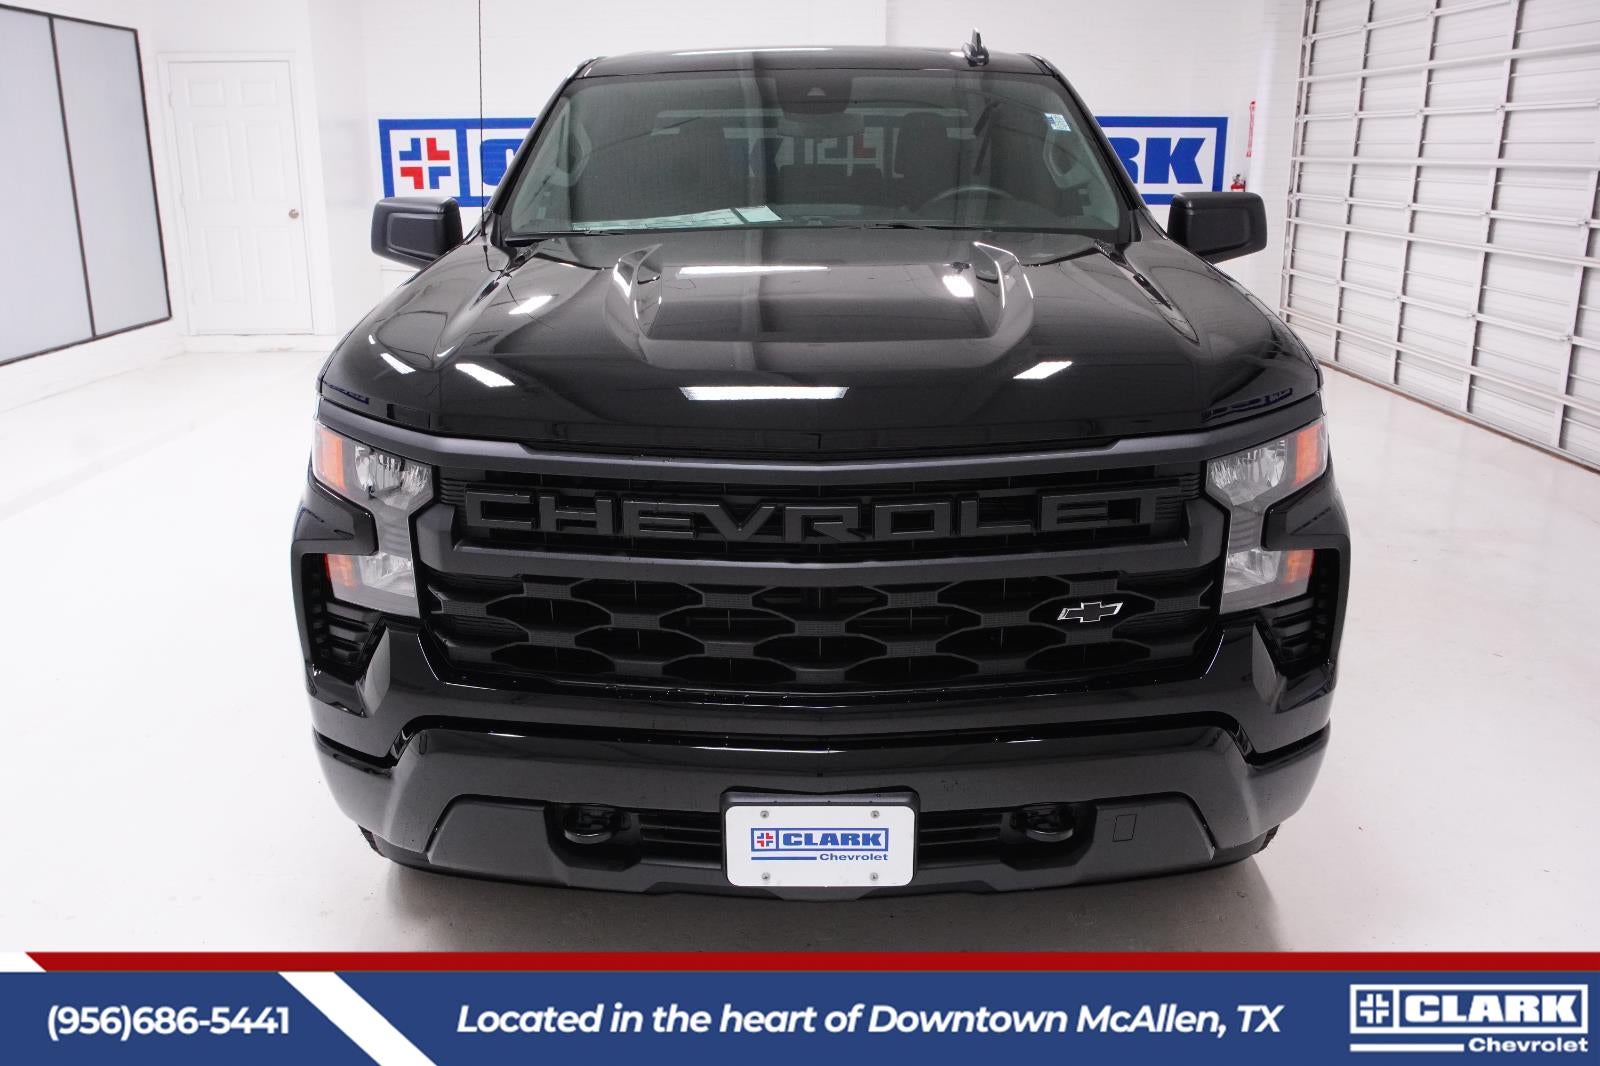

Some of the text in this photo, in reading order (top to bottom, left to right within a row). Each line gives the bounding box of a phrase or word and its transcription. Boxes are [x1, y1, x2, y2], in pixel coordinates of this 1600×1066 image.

[466, 486, 1180, 543] CHEVROLET
[782, 832, 882, 847] CLARK
[819, 853, 889, 861] Chevrolet
